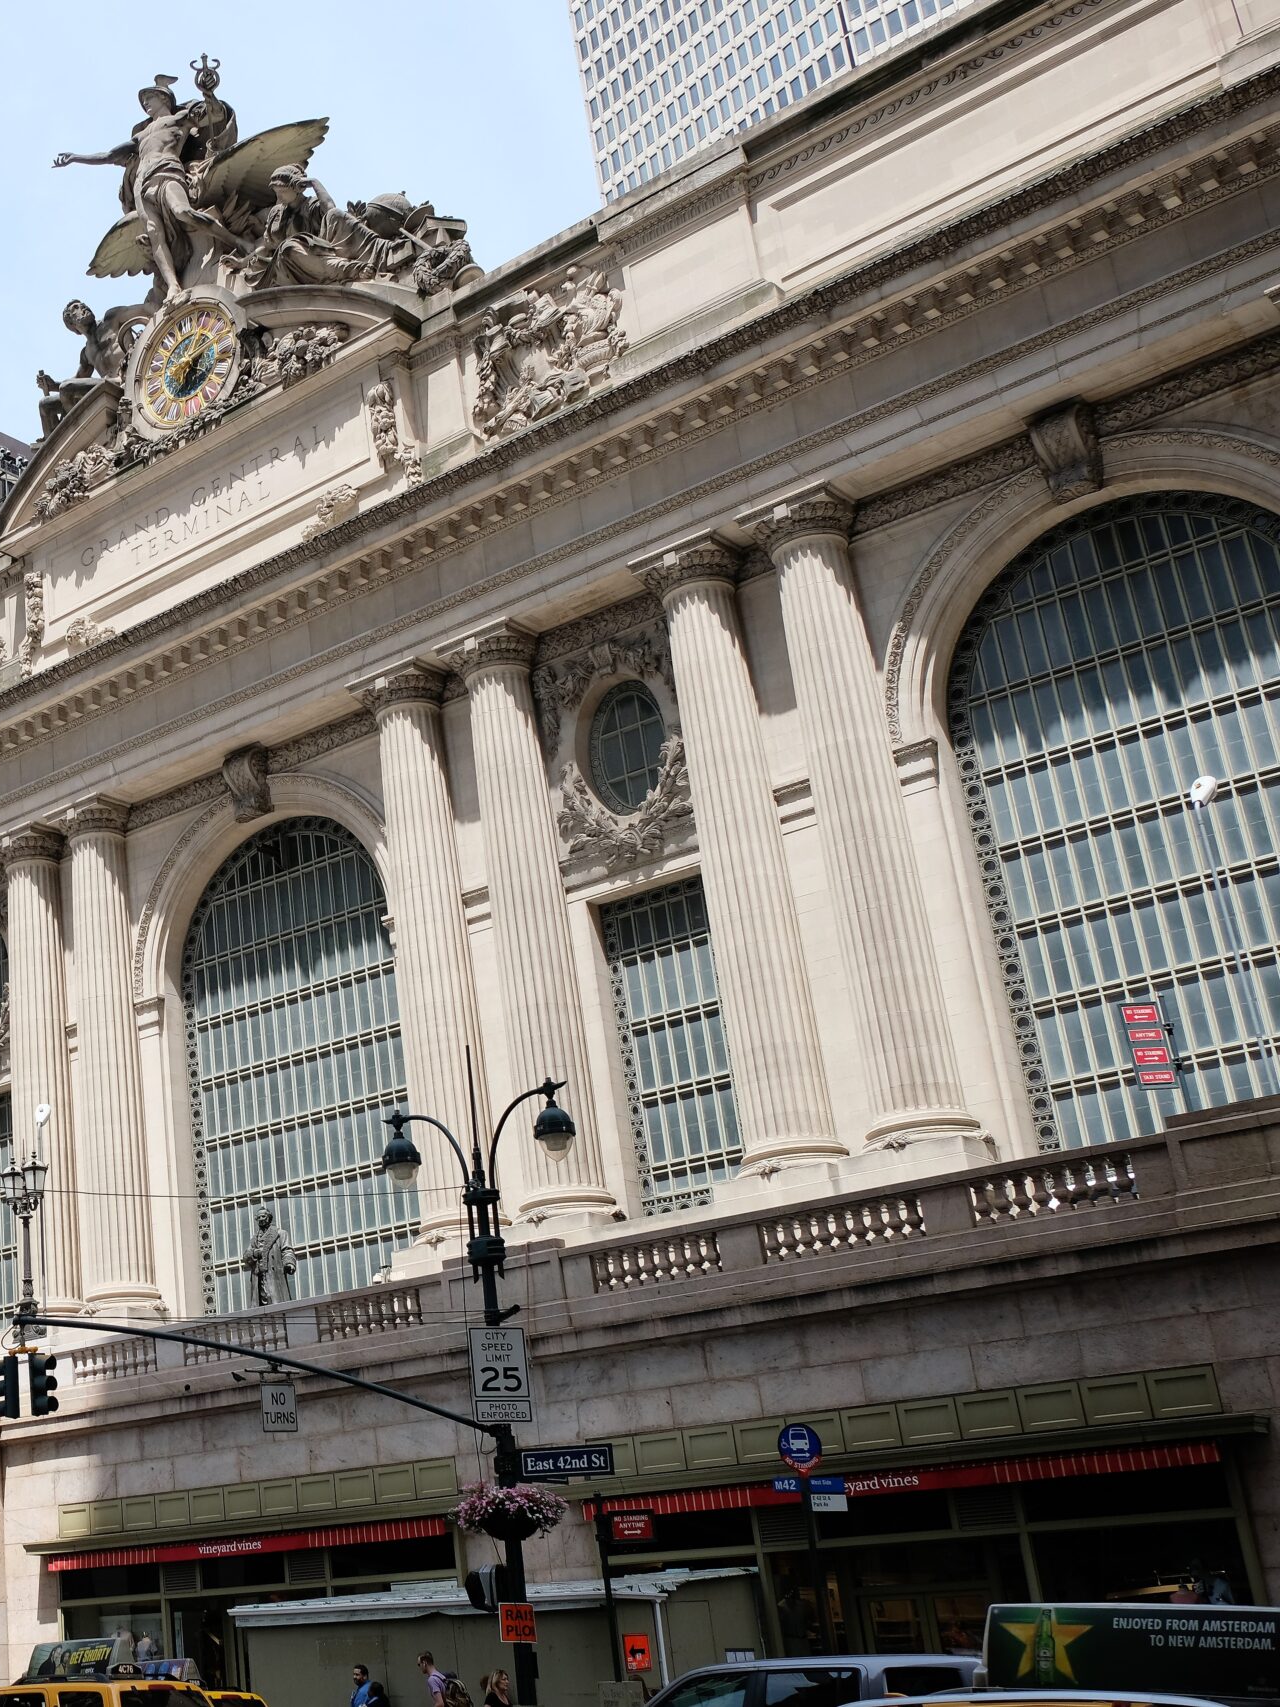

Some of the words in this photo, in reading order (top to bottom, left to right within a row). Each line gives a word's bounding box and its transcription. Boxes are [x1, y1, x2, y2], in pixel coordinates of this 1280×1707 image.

[80, 506, 170, 567] GRAND
[192, 424, 326, 506] CENTRAL
[131, 480, 270, 566] TERMINAL
[481, 1343, 513, 1351] SPEED
[485, 1354, 510, 1362] LIMIT
[480, 1367, 522, 1392] 25
[271, 1392, 286, 1405] NO
[264, 1412, 295, 1424] TURNS
[526, 1457, 554, 1471] East
[557, 1454, 588, 1469] 42nd
[591, 1453, 605, 1467] St
[784, 1457, 793, 1466] NO
[775, 1480, 796, 1490] M42
[844, 1476, 881, 1495] eyard
[882, 1474, 919, 1488] vines
[198, 1541, 236, 1556] vineyard
[237, 1541, 262, 1550] vines
[1113, 1617, 1163, 1630] ENJOYED
[1166, 1618, 1199, 1631] FROM
[1202, 1620, 1276, 1634] AMSTERDAM
[1150, 1634, 1165, 1646] TO
[1168, 1635, 1195, 1648] NEW
[1199, 1636, 1276, 1651] AMSTERDAM.
[70, 1652, 84, 1665] GET
[83, 1647, 112, 1662] SHORTY
[118, 1664, 134, 1674] 4C76
